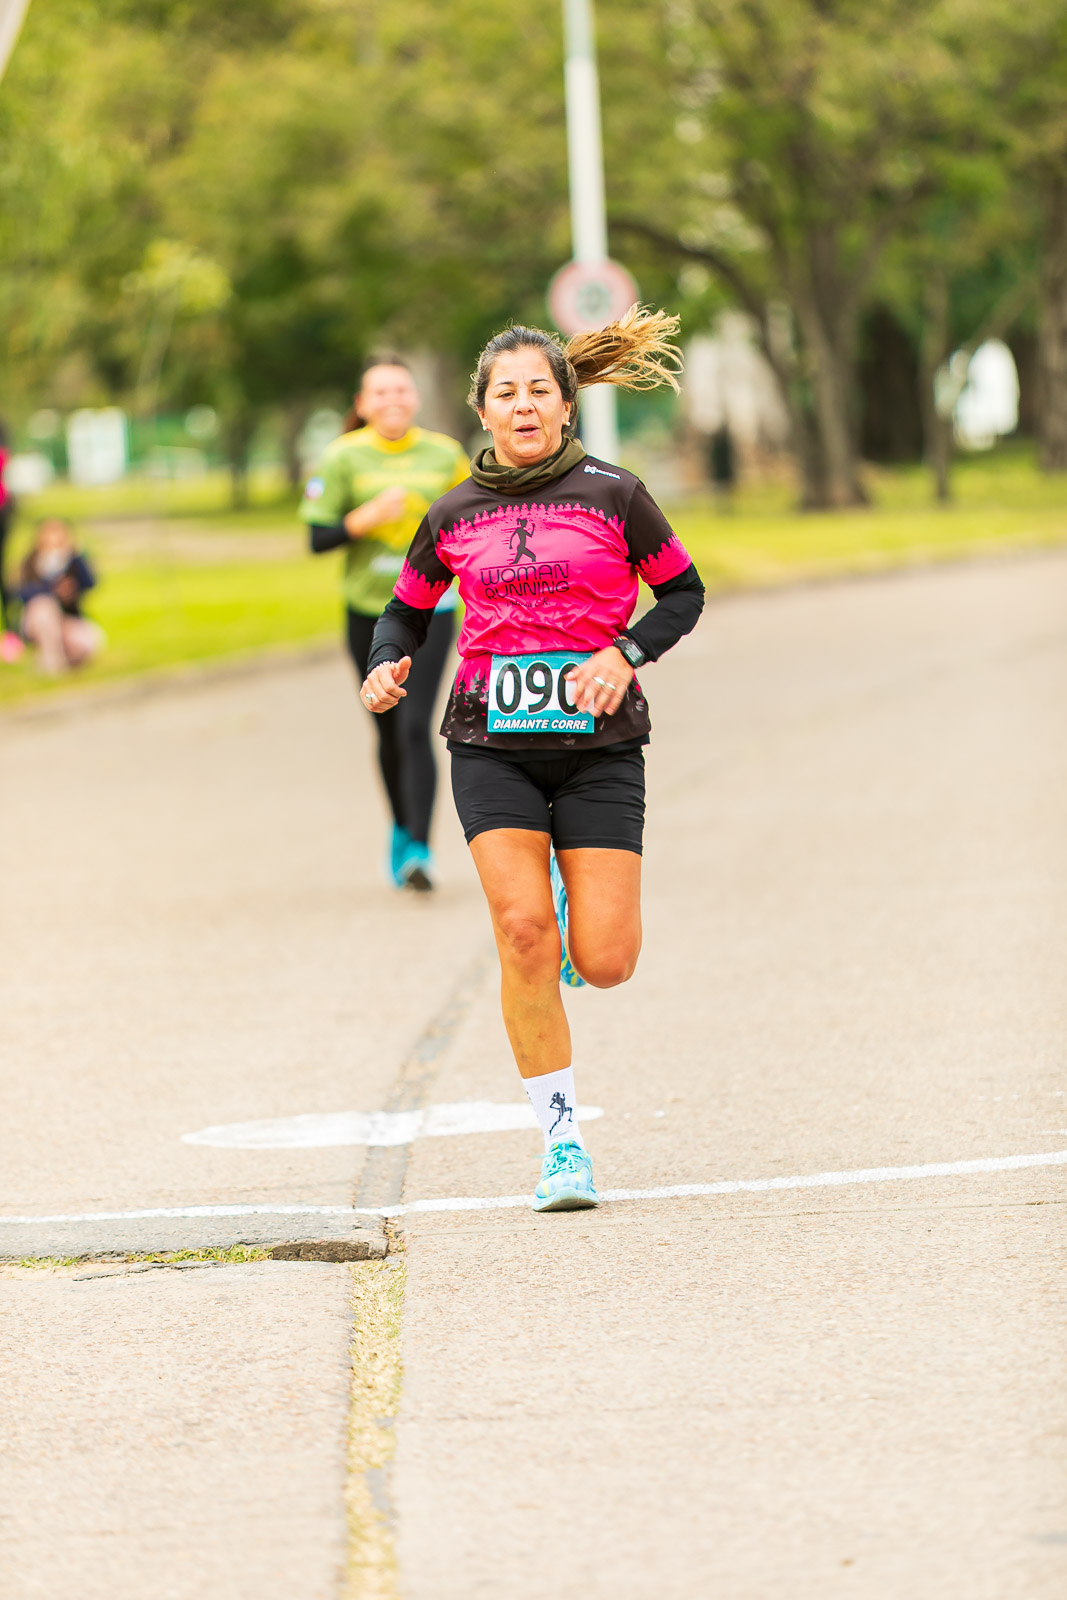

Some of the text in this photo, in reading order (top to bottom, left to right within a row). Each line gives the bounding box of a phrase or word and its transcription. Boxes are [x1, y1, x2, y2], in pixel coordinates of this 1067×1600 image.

[480, 563, 569, 586] WOMAN
[484, 580, 570, 600] RUNNING
[492, 718, 589, 730] DIAMANTE CORRE
